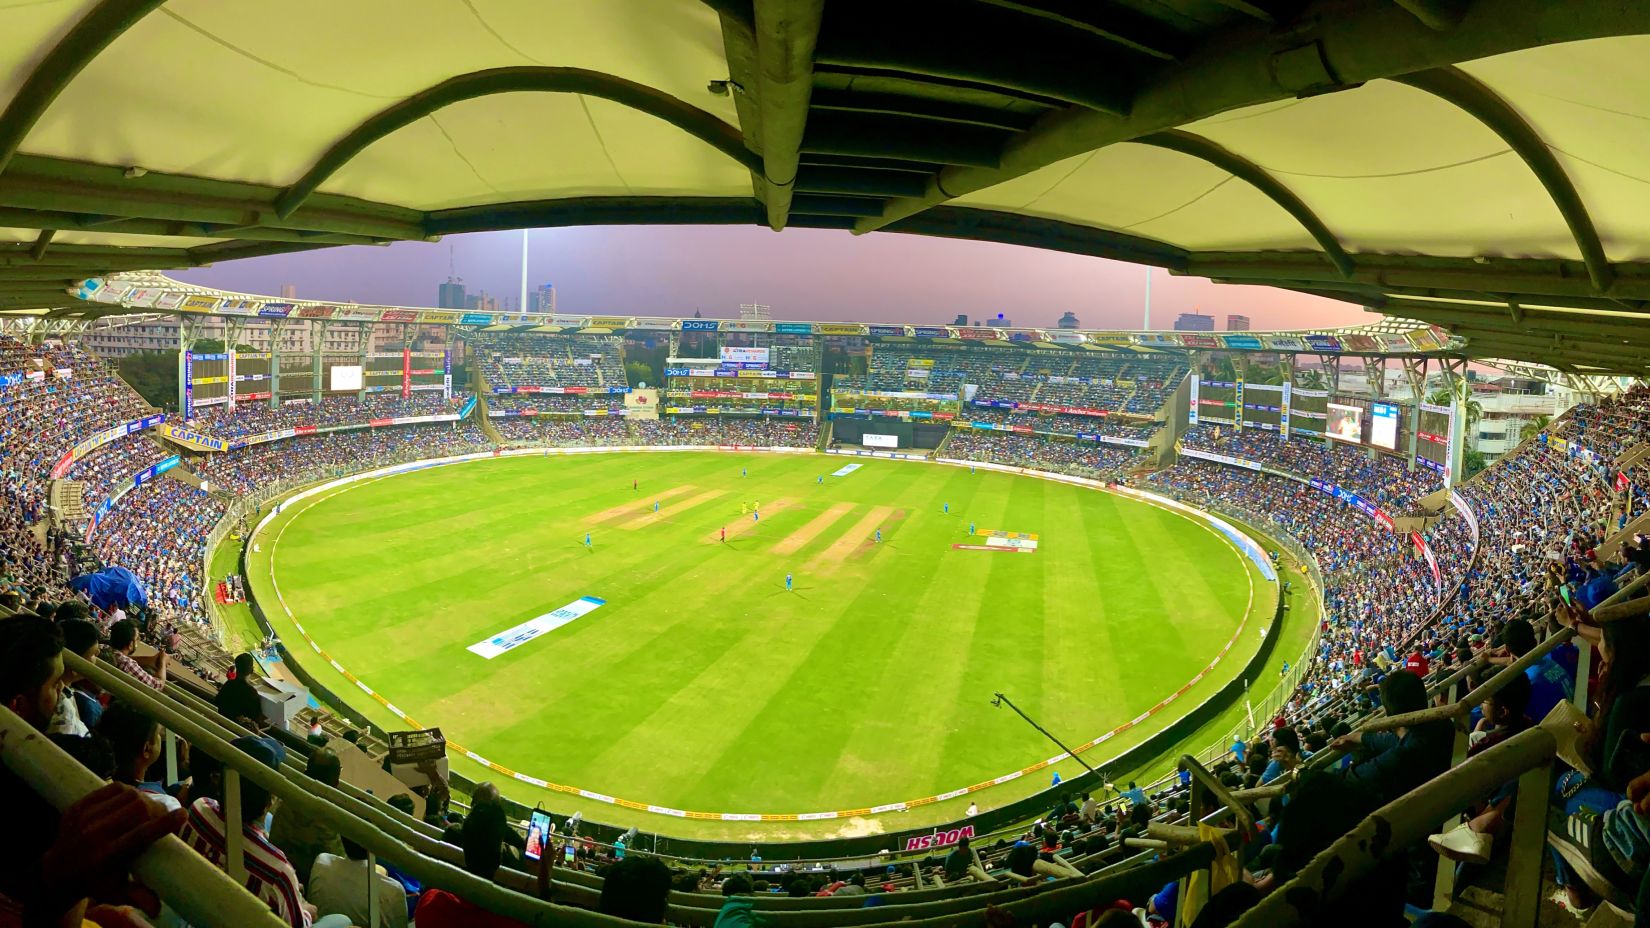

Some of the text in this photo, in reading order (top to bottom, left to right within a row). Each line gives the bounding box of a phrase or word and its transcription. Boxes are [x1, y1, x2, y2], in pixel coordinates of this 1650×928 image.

[683, 321, 717, 329] DOMS
[171, 428, 223, 449] CAPTAIN
[907, 825, 975, 850] WOOSH
